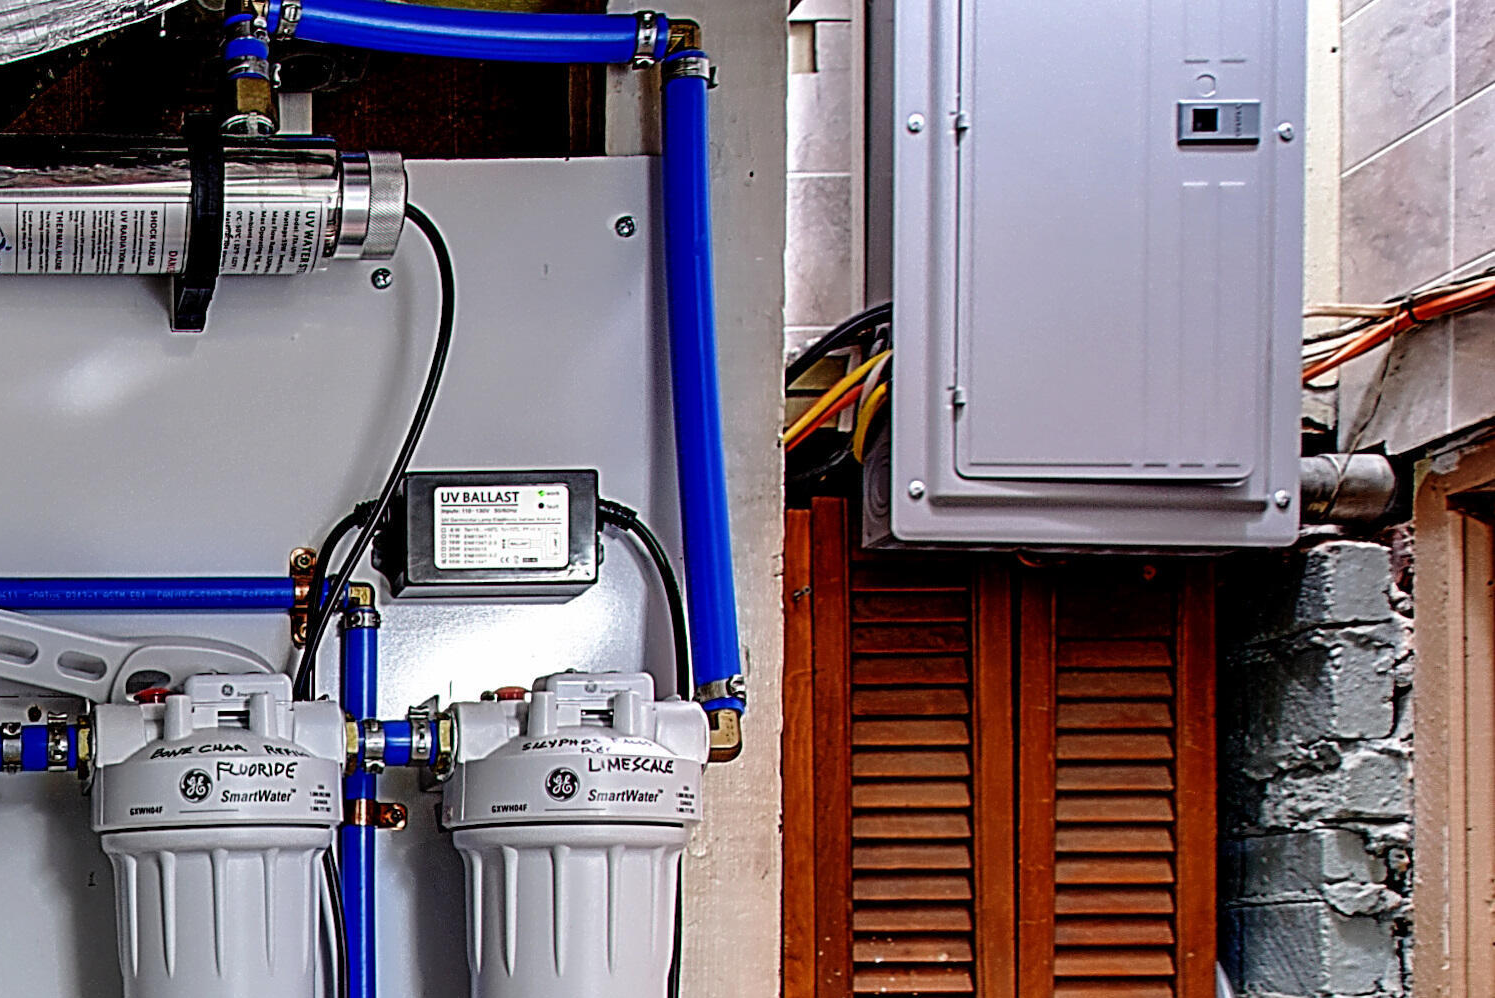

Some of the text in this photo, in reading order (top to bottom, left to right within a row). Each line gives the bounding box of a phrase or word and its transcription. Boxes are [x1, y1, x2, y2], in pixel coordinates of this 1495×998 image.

[120, 210, 127, 222] UV
[305, 211, 315, 227] UV
[150, 210, 158, 240] SHOCK
[300, 231, 314, 263] WATER
[441, 492, 519, 503] UV BALLAST
[150, 746, 194, 759] BONE
[198, 744, 248, 752] CHAR
[216, 761, 298, 781] FLUORIDE
[588, 757, 674, 774] LIMESCALE
[491, 803, 528, 814] GXWH04F
